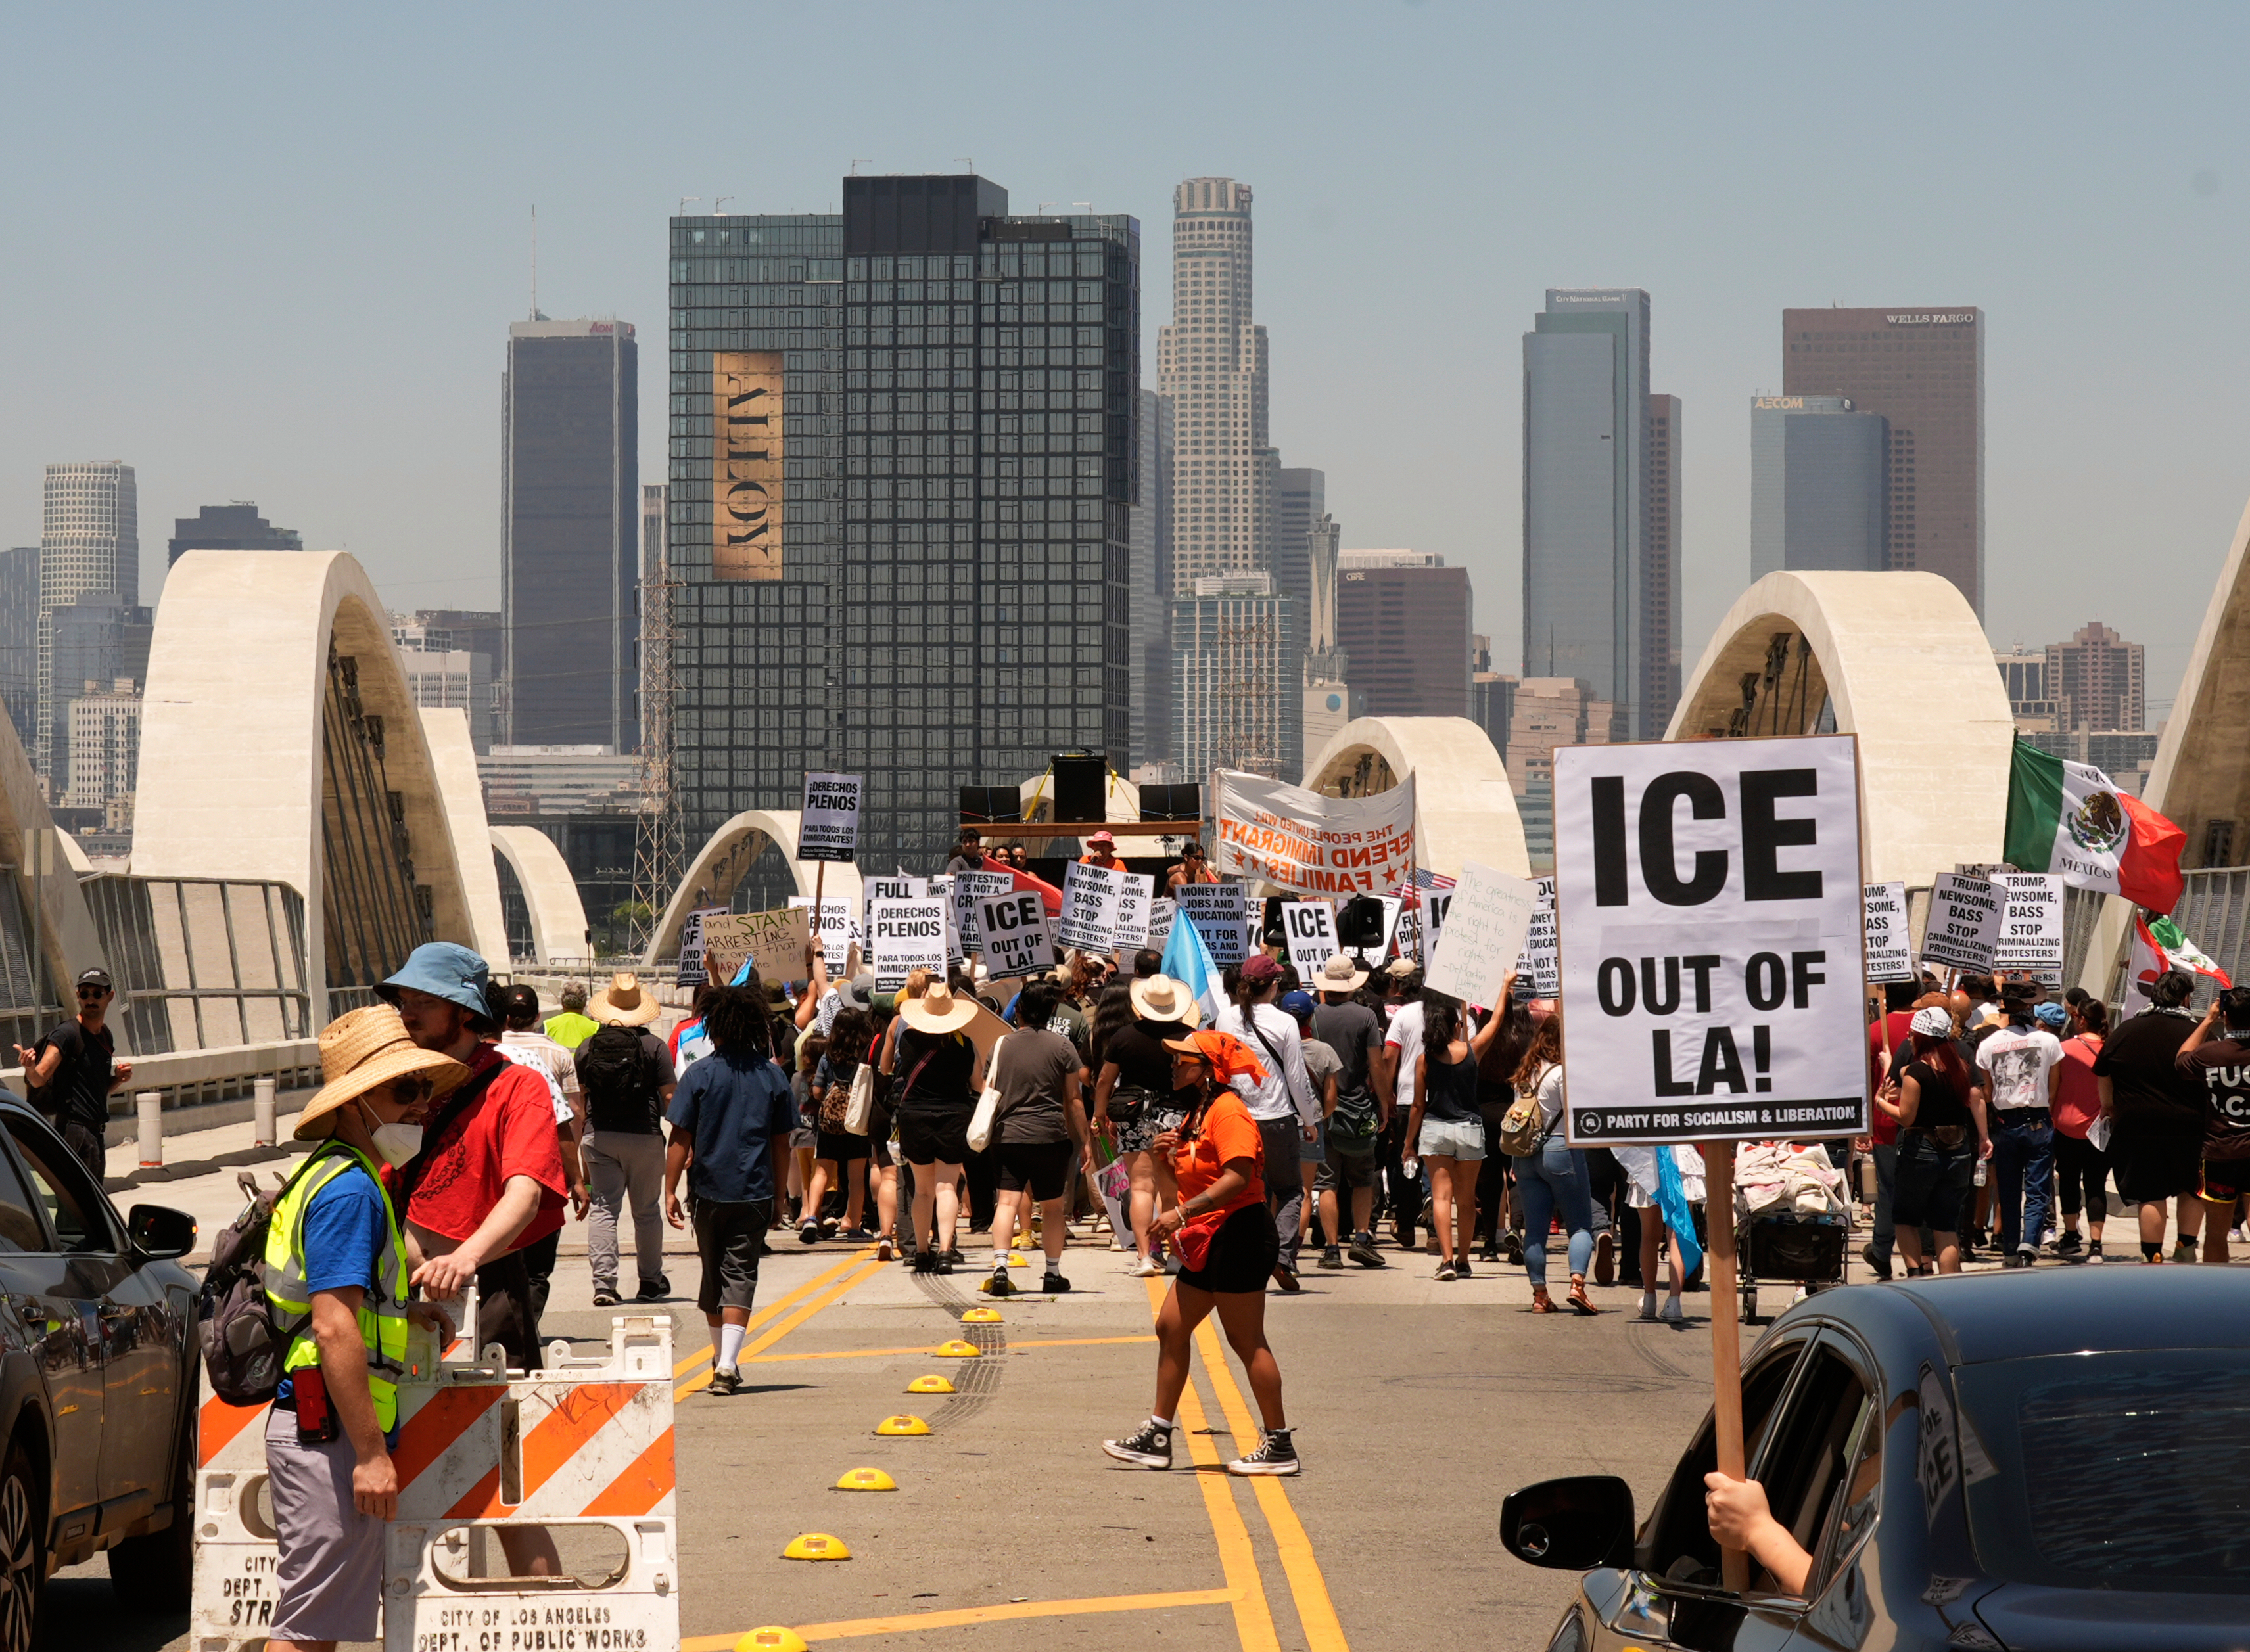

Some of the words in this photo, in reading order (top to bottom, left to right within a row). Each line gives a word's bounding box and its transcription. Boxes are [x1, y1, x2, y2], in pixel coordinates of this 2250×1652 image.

[1887, 315, 1930, 323] WELLS
[1933, 314, 1973, 323] FARGO
[1755, 398, 1803, 409] AECOM
[727, 374, 769, 558] ALLOY
[809, 781, 858, 794] ¡DERECHOS
[807, 794, 856, 811] PLENOS
[803, 834, 853, 844] INMIGRANTES!
[1591, 768, 1823, 907] ICE
[1076, 865, 1109, 883] TRUMP,
[2059, 858, 2112, 879] MEXICO
[957, 874, 1010, 885] PROTESTING
[1067, 876, 1115, 897] NEWSOME,
[1952, 877, 1992, 897] TRUMP,
[2006, 877, 2046, 888] TRUMP,
[875, 882, 913, 898] FULL
[963, 884, 971, 892] IS
[973, 885, 991, 894] NOT
[1181, 887, 1216, 896] MONEY
[1220, 887, 1239, 896] FOR
[1074, 892, 1103, 907] BASS
[1185, 899, 1211, 909] JOBS
[1214, 900, 1234, 909] AND
[1468, 896, 1505, 917] America
[1938, 890, 1998, 913] NEWSOME,
[878, 907, 941, 921] ¡DERECHOS
[984, 897, 1039, 932] ICE
[1072, 907, 1099, 922] STOP
[1118, 913, 1133, 923] OP
[1531, 913, 1551, 923] ONEY
[1949, 905, 1984, 923] BASS
[2009, 906, 2044, 918] BASS
[685, 914, 701, 929] ICE
[705, 918, 730, 930] and
[736, 909, 803, 936] START
[962, 923, 976, 932] ALL
[1061, 916, 1113, 934] CRIMINALIZING
[1288, 908, 1330, 938] ICE
[1449, 906, 1462, 919] the
[1468, 916, 1489, 934] right
[1494, 922, 1505, 936] to
[878, 921, 941, 938] PLENOS
[1061, 927, 1108, 944] PROTESTERS!
[1217, 930, 1238, 940] FOR
[1530, 927, 1548, 936] JOBS
[1947, 923, 1979, 938] STOP
[2011, 925, 2042, 935] STOP
[684, 930, 698, 946] OF
[706, 928, 790, 949] ARRESTING
[764, 938, 797, 953] that
[991, 938, 1020, 953] OUT
[1025, 934, 1043, 948] OF
[1485, 938, 1504, 953] for
[1927, 932, 1993, 954] CRIMINALIZING
[683, 950, 700, 960] END
[1006, 950, 1034, 969] LA!
[1297, 949, 1317, 962] OUT
[1928, 943, 1987, 963] PROTESTERS!
[1534, 957, 1553, 968] NOT
[1456, 975, 1483, 991] Luther
[1598, 955, 1720, 1017] OUT
[1745, 950, 1826, 1011] OF
[1455, 986, 1473, 1001] King
[1652, 1025, 1772, 1097] LA!
[1607, 1114, 1649, 1128] PARTY
[1653, 1113, 1681, 1128] FOR
[1683, 1109, 1758, 1127] SOCIALISM
[1760, 1110, 1773, 1123] &
[1775, 1105, 1856, 1123] LIBERATION
[245, 1557, 276, 1572] CITY
[223, 1578, 270, 1597] DEPT.
[441, 1610, 473, 1626] CITY
[482, 1610, 500, 1626] OF
[511, 1609, 537, 1625] LOS
[545, 1607, 611, 1624] ANGELES
[418, 1632, 468, 1652] DEPT.
[480, 1632, 501, 1651] OF
[512, 1630, 576, 1651] PUBLIC
[585, 1628, 646, 1649] WORKS
